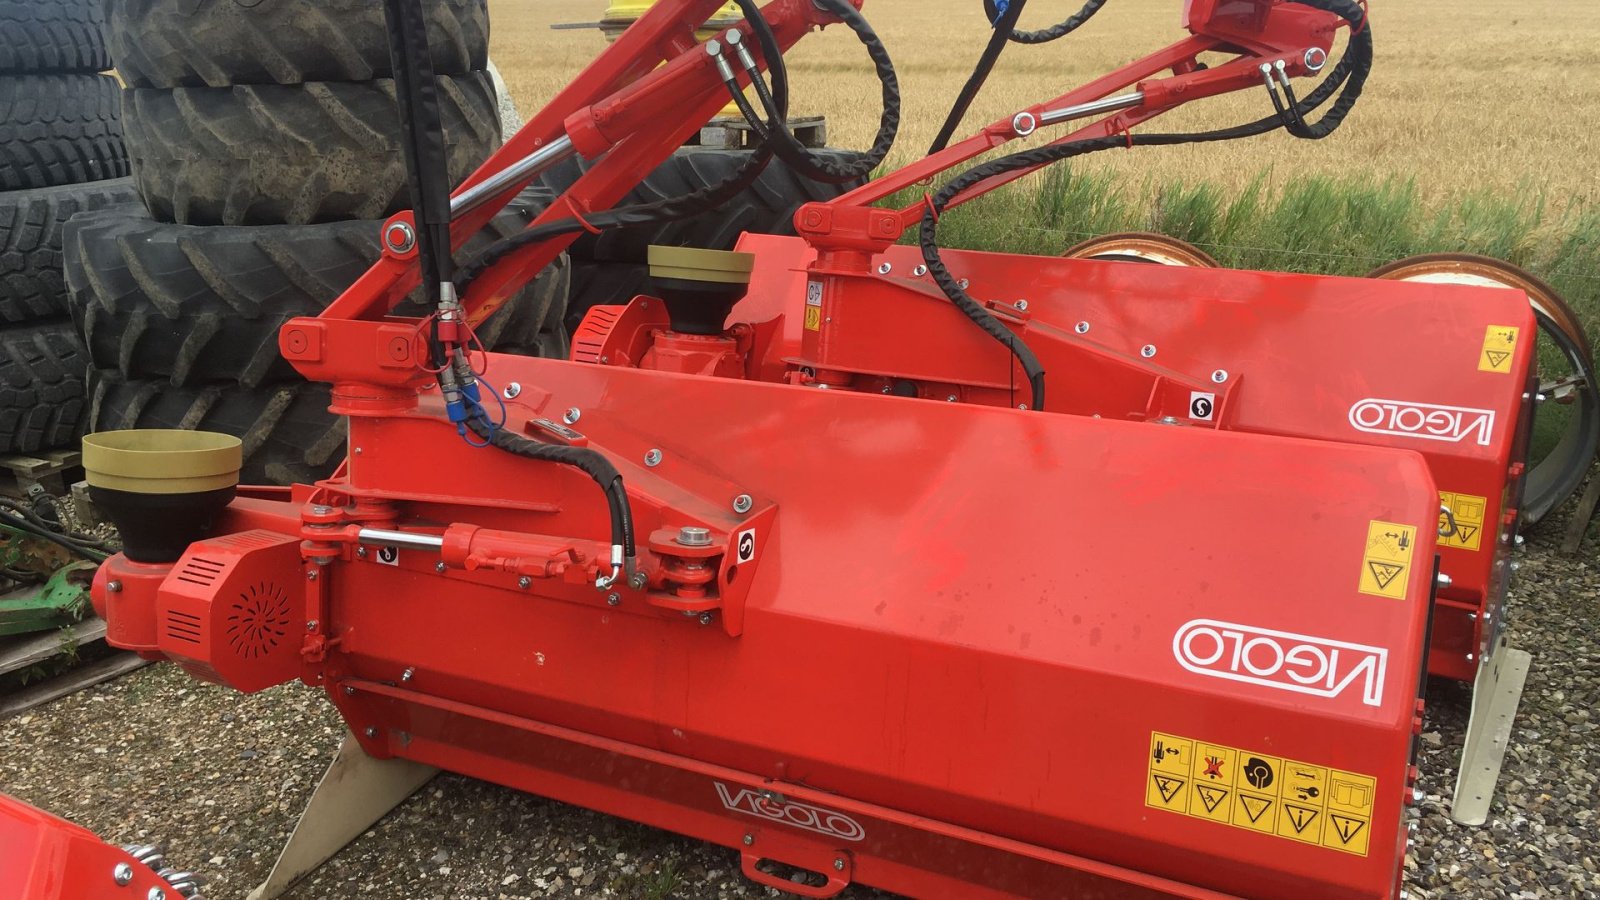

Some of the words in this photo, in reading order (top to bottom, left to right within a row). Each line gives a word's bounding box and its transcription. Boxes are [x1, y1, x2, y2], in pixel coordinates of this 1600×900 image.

[1355, 403, 1496, 446] VIGOLO
[1182, 626, 1389, 707] VIGOLO
[713, 781, 858, 837] VIGOLO
